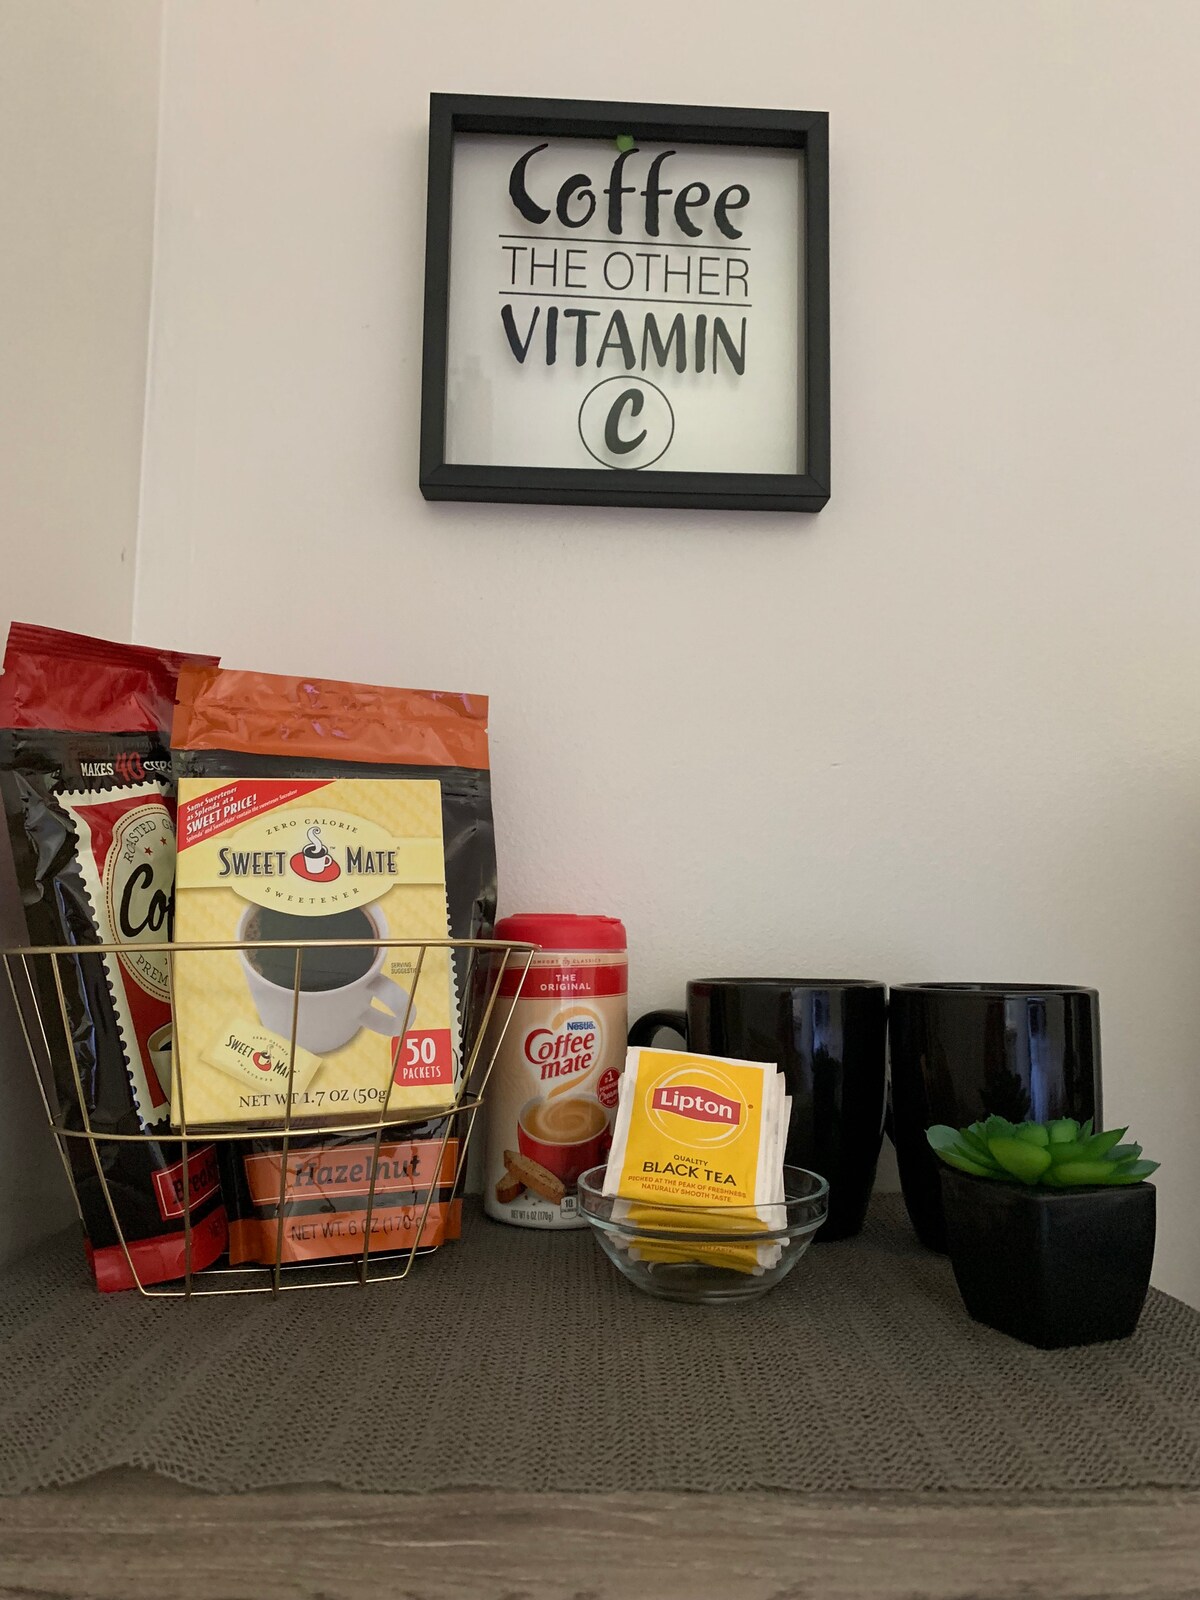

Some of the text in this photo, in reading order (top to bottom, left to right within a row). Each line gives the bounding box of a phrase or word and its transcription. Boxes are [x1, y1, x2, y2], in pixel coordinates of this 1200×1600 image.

[509, 143, 750, 239] Coffee
[501, 246, 749, 297] THE OTHER
[500, 304, 747, 375] VITAMIN
[604, 388, 648, 454] C
[80, 752, 172, 782] MAKES 40 CUPS
[186, 786, 238, 813] Same Sweetener
[222, 797, 229, 805] at
[186, 808, 222, 835] SWEET
[223, 793, 257, 818] PRICE!
[204, 826, 213, 834] and
[251, 804, 259, 813] the
[265, 818, 358, 836] ZERO CALORIE
[124, 820, 157, 864] ROASTED
[219, 847, 286, 875] SWEET
[265, 886, 360, 904] SWEETENER
[540, 982, 592, 991] ORIGINAL
[555, 974, 577, 982] THE
[225, 1034, 255, 1058] SWEET
[406, 1037, 436, 1066] 50
[524, 1028, 595, 1065] Coffee
[403, 1065, 442, 1080] PACKETS
[540, 1052, 592, 1080] mate
[239, 1094, 271, 1108] NET
[274, 1092, 299, 1105] WT
[303, 1091, 326, 1107] 1.7
[329, 1089, 349, 1102] OZ
[660, 1090, 733, 1119] Lipton
[294, 1154, 421, 1187] Hazelnut
[642, 1161, 737, 1187] BLACK TEA
[673, 1154, 709, 1167] QUALITY
[641, 1183, 680, 1195] NATURALLY
[680, 1189, 710, 1199] SMOOTH
[664, 1178, 677, 1186] THE
[678, 1180, 696, 1189] PEAK
[708, 1185, 747, 1199] FRESHNESS
[565, 1199, 573, 1208] 10
[291, 1223, 318, 1241] NET
[322, 1221, 345, 1239] WT.
[349, 1220, 357, 1235] 6
[361, 1218, 380, 1234] OZ
